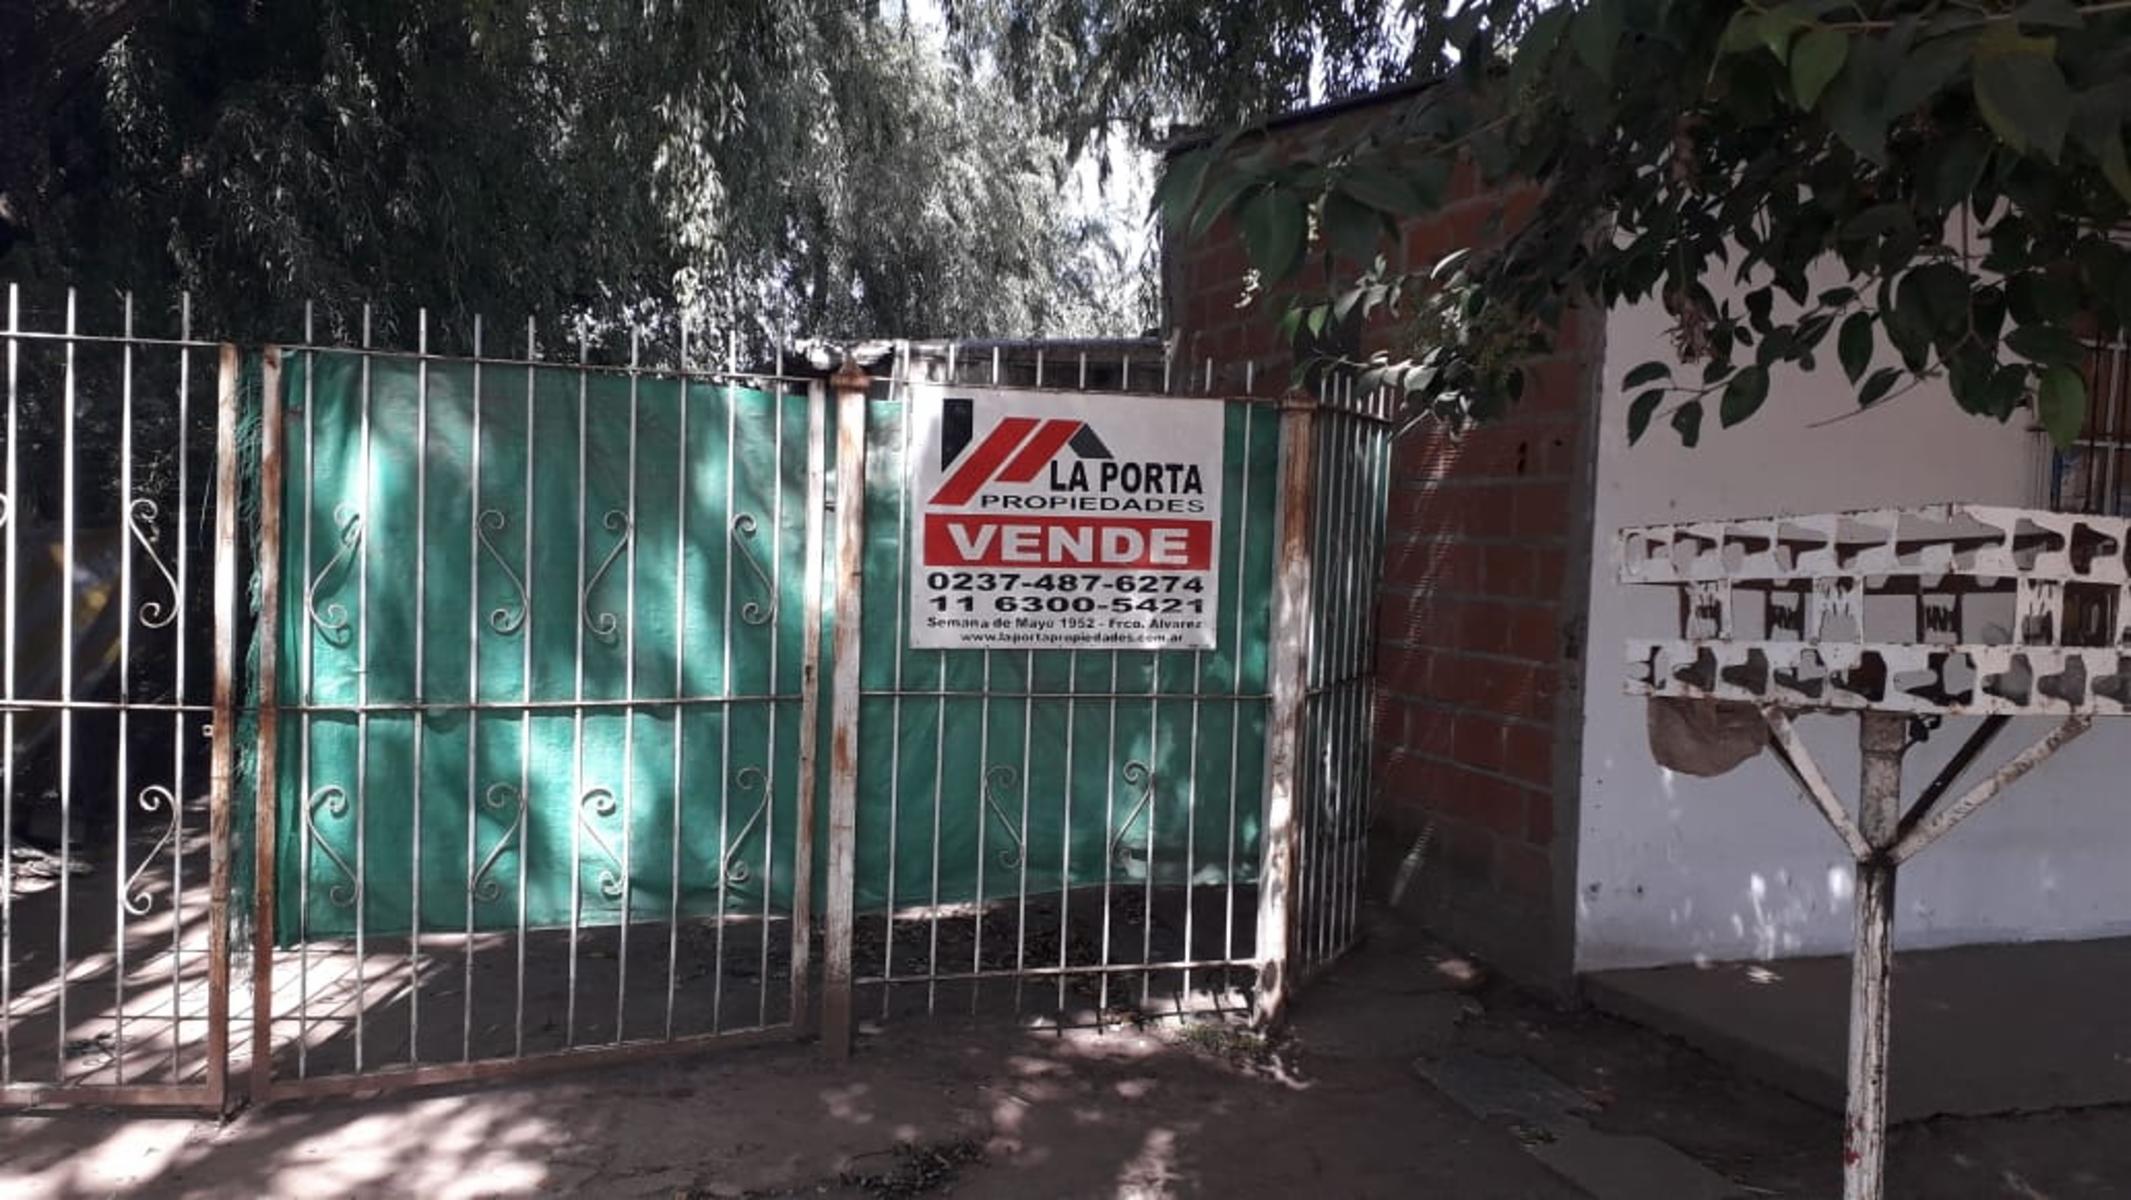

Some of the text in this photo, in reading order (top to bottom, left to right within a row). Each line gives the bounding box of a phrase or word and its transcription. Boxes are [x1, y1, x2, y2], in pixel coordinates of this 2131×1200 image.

[1050, 459, 1203, 494] LA PORTA
[980, 495, 1204, 512] PROPIEDADES
[947, 523, 1189, 565] VENDE
[927, 572, 1204, 593] 0237-487-6274
[929, 595, 1203, 613] 11 6300-5421
[927, 617, 988, 629] Semana
[993, 618, 1011, 629] de
[1015, 617, 1053, 632] Mayo
[1062, 618, 1093, 629] 1952
[961, 631, 1183, 644] www.laportapropiedades.com.ar
